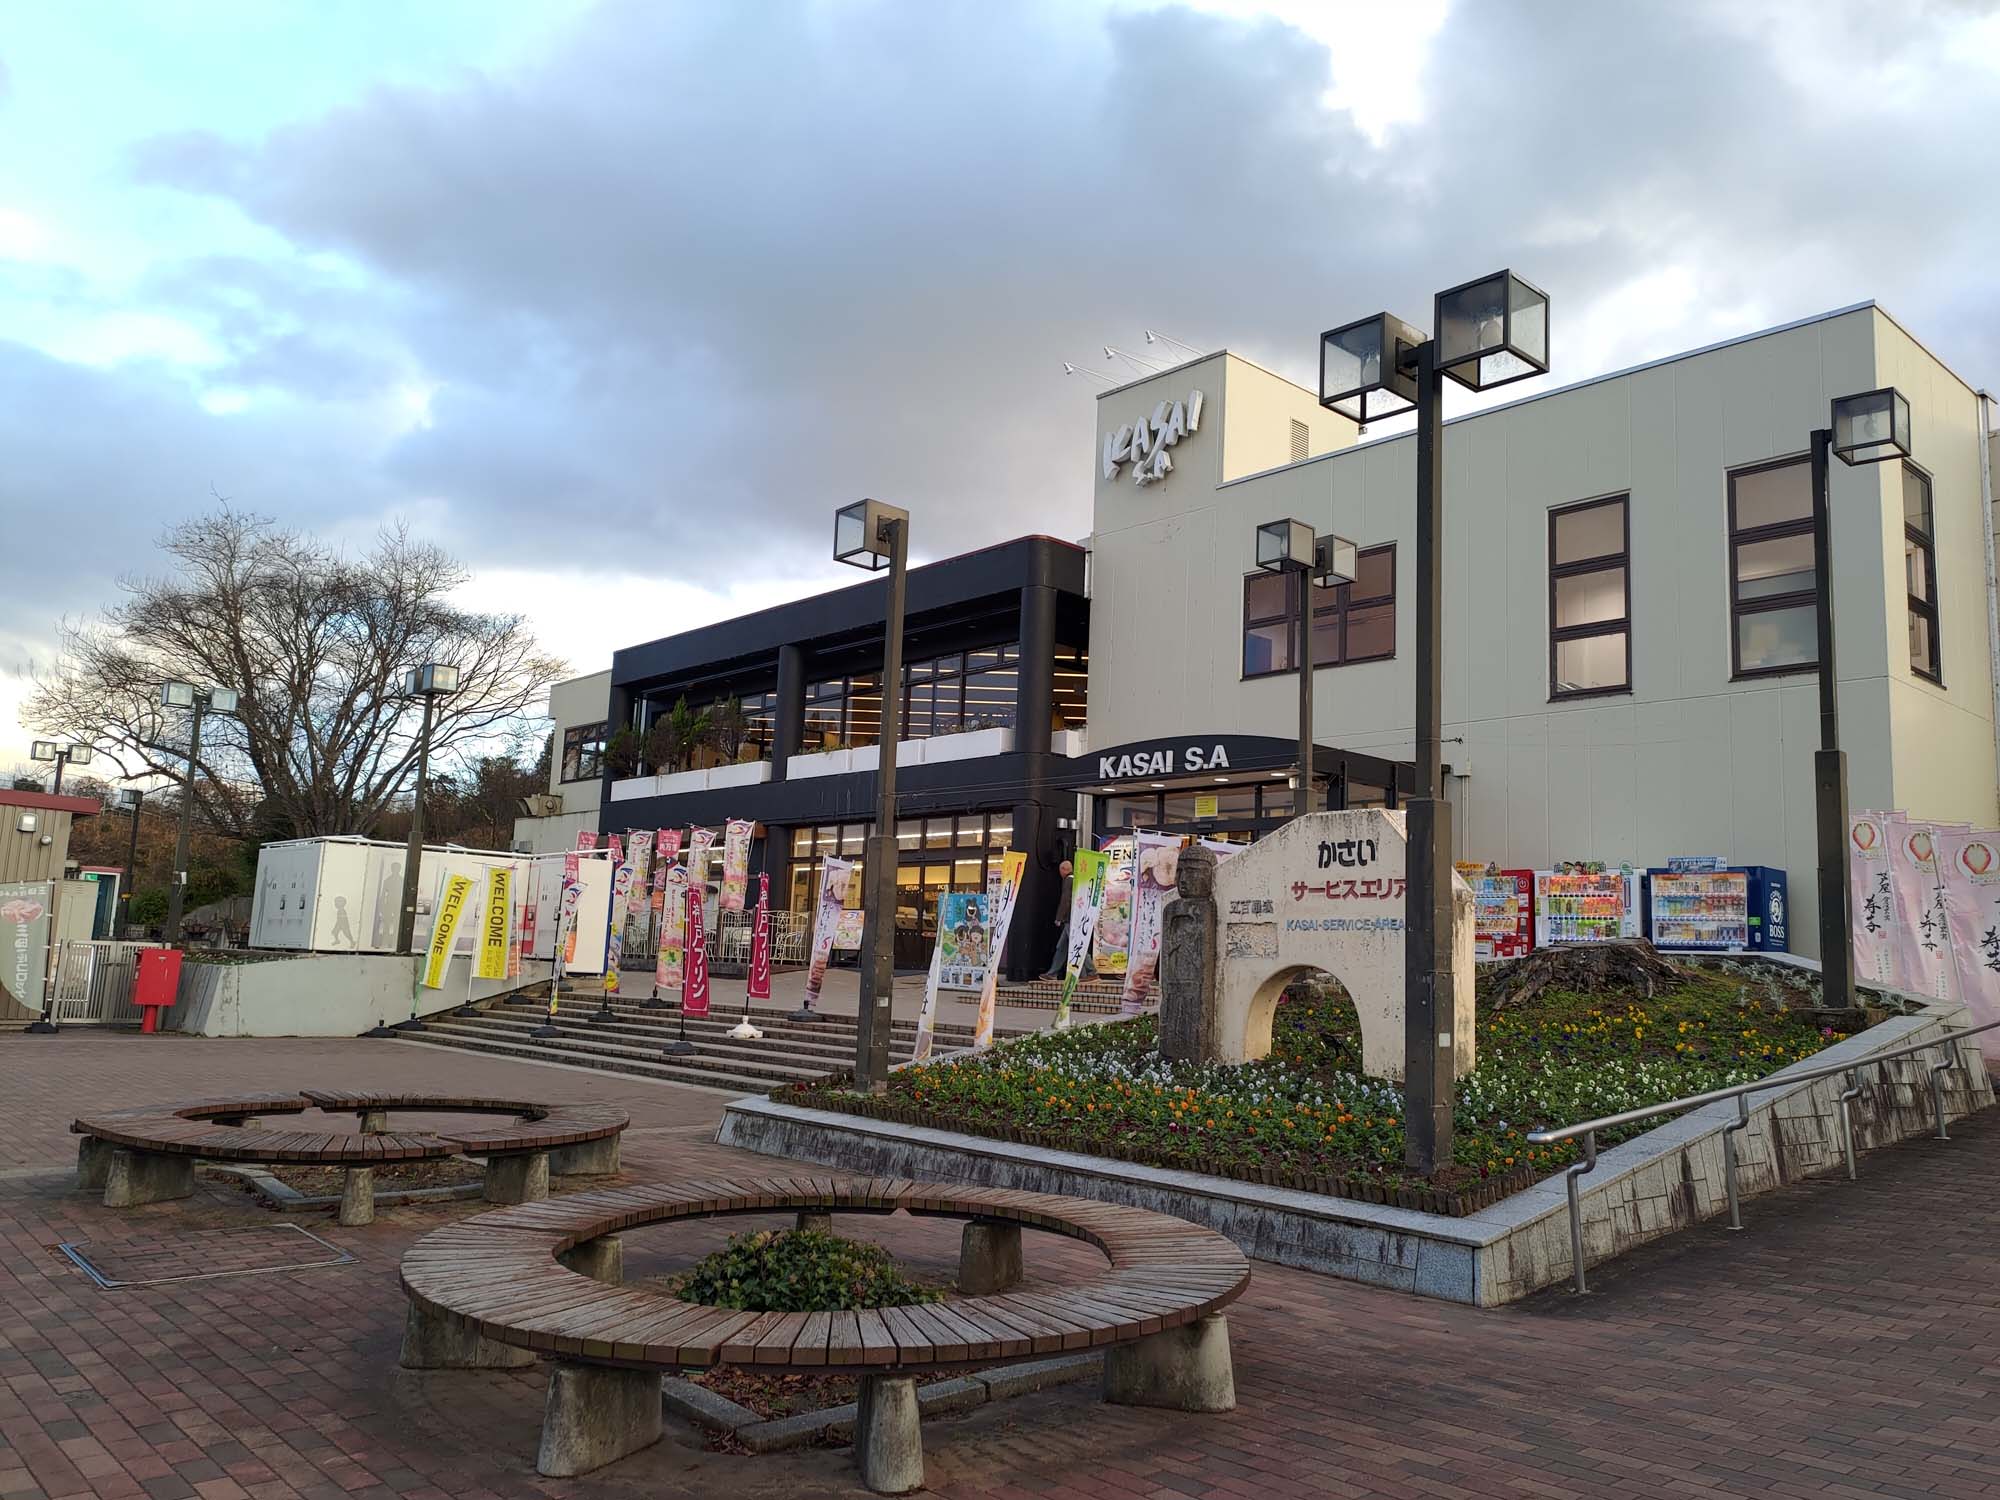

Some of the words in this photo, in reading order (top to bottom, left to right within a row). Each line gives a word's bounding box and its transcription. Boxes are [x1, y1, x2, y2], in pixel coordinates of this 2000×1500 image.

[1103, 390, 1204, 480] KASAI
[1099, 750, 1174, 779] KASAI
[1184, 744, 1230, 771] S.A
[1318, 838, 1376, 869] かさい
[1291, 877, 1406, 902] サービスエリア
[432, 881, 467, 955] WELCOME
[488, 872, 506, 947] WELCOME
[1769, 923, 1785, 939] BOSS
